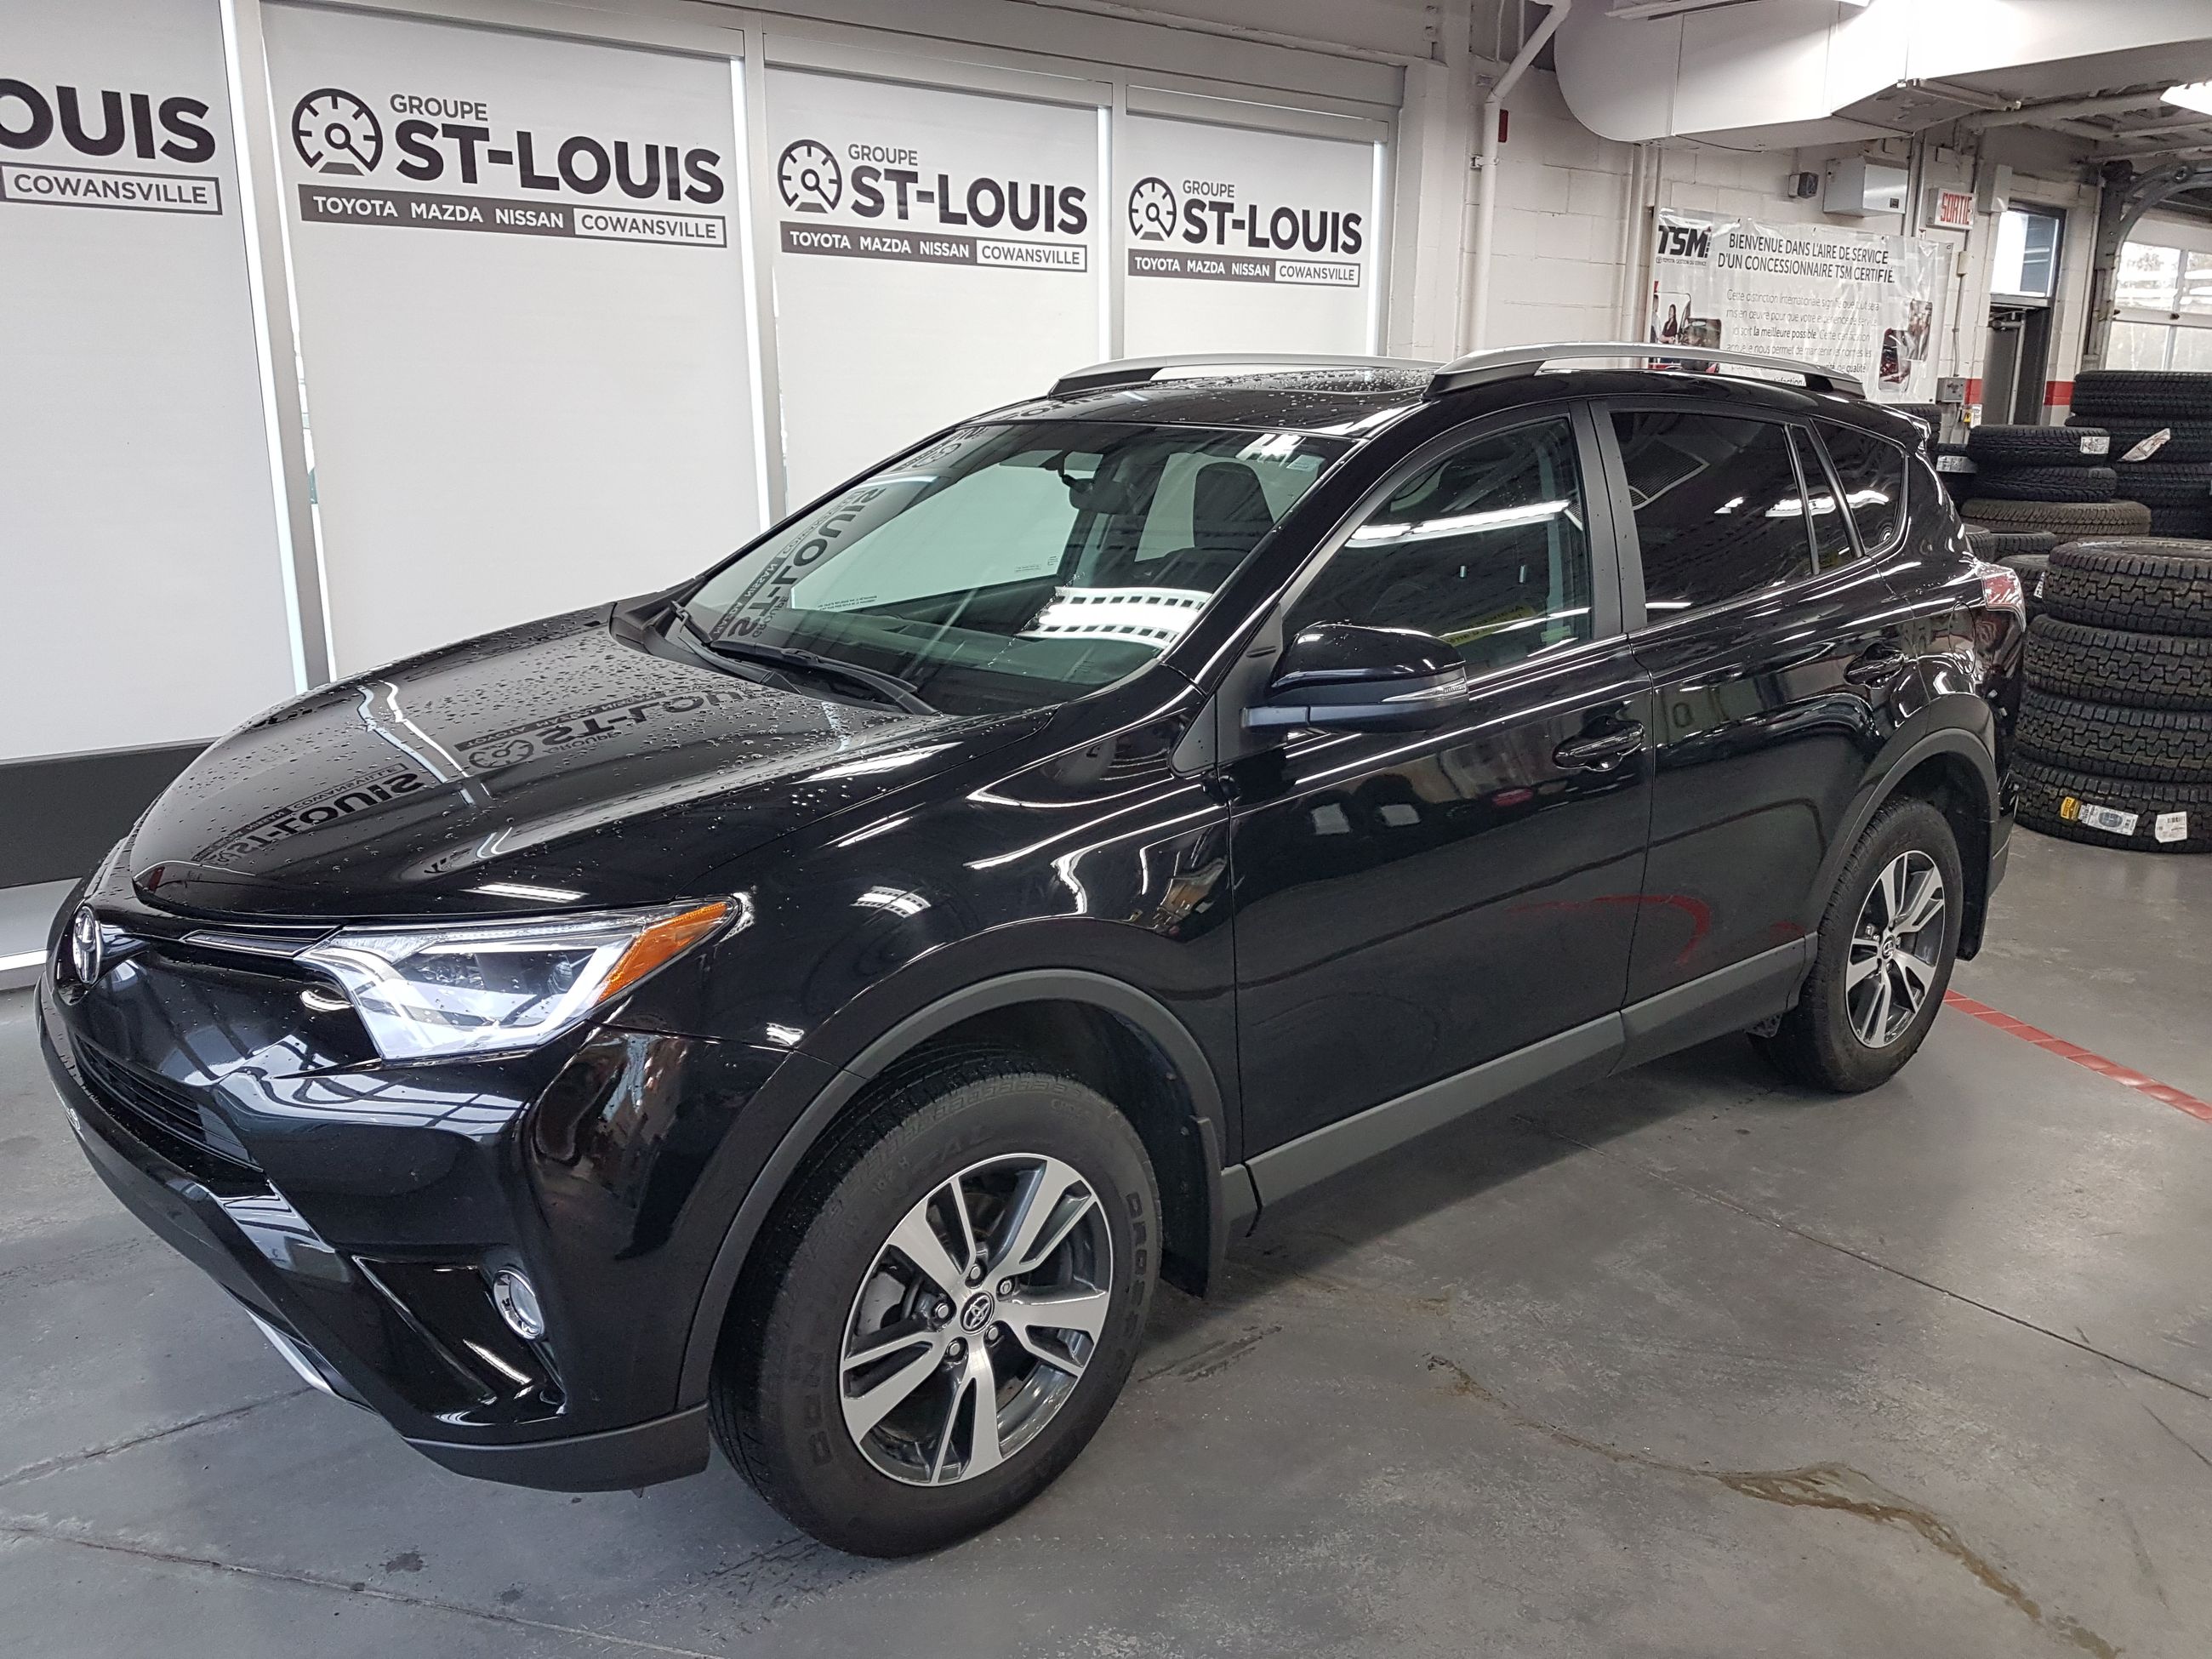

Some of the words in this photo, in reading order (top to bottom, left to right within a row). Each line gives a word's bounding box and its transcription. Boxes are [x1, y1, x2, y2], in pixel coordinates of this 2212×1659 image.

[390, 94, 488, 121] GROUPE
[396, 119, 724, 204] ST-LOUIS
[848, 144, 918, 166] GROUPE
[14, 174, 208, 204] COWANSVILLE
[851, 165, 1087, 235] ST-LOUIS
[1183, 180, 1234, 198] GROUPE
[313, 196, 398, 217] TOYOTA
[411, 202, 483, 223] MAZDA
[496, 208, 564, 228] NISSAN
[581, 214, 716, 239] COWANSVILLE
[1941, 192, 1972, 225] SORTIE
[1183, 198, 1362, 254] ST-LOUIS
[1658, 225, 1708, 259] TSM
[790, 231, 851, 249] TOYOTA
[859, 237, 911, 254] MAZDA
[920, 241, 969, 258] NISSAN
[982, 246, 1080, 265] COWANSVILLE
[1729, 233, 1783, 254] BIENVENUE
[1786, 240, 1810, 256] DANS
[1812, 242, 1836, 259] L'AIRE
[1839, 247, 1850, 260] DE
[1852, 247, 1889, 265] SERVICE
[1135, 256, 1180, 272] TOYOTA
[1187, 259, 1225, 274] MAZDA
[1232, 263, 1270, 276] NISSAN
[1280, 265, 1354, 281] COWANSVILLE
[1718, 253, 1742, 269] D'UN
[1745, 255, 1833, 278] CONCESSIONNAIRE
[1834, 265, 1852, 280] TSM
[1753, 325, 1759, 336] la
[1761, 327, 1791, 338] meilleure
